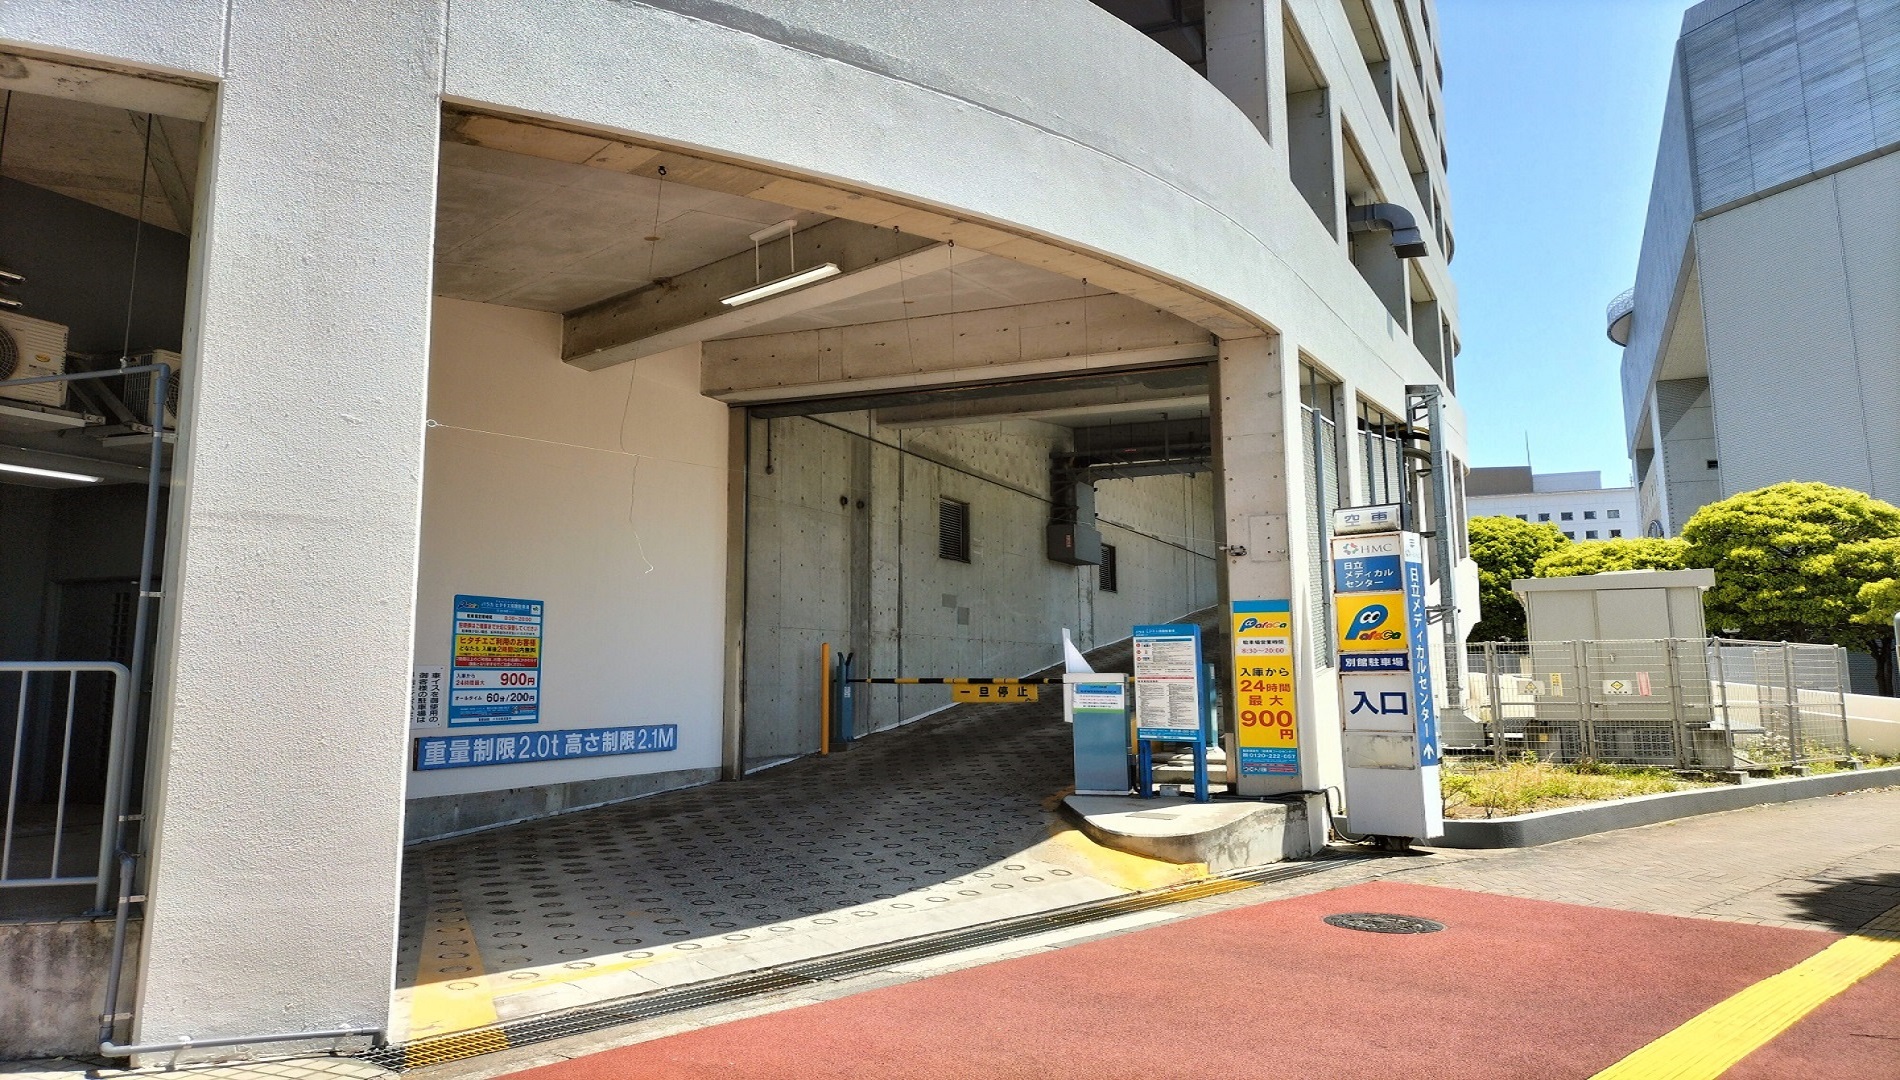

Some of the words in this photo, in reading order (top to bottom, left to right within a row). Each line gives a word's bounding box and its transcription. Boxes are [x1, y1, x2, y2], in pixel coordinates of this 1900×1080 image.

[1344, 511, 1389, 528] 空車
[1361, 543, 1392, 554] HMC
[1343, 561, 1364, 571] 日立
[1345, 568, 1394, 579] メディカル
[1345, 579, 1384, 588] センター
[1410, 567, 1430, 738] 日立メディカルセンター
[1345, 657, 1404, 667] 別館駐車場
[1240, 667, 1289, 676] 入庫から
[500, 673, 535, 686] 900円
[1240, 679, 1291, 692] 24時間
[416, 672, 429, 723] 御客様の駐車場は
[428, 672, 441, 722] 車イスを御使用の
[486, 692, 535, 703] 60分/200円
[960, 686, 1028, 697] 一旦停止
[1249, 694, 1284, 706] 最大
[1350, 691, 1408, 715] 入口
[1241, 710, 1293, 727] 900
[1280, 729, 1294, 740] 円
[424, 734, 559, 766] 重量制限2.0t
[565, 727, 674, 755] 高さ制限2.1M
